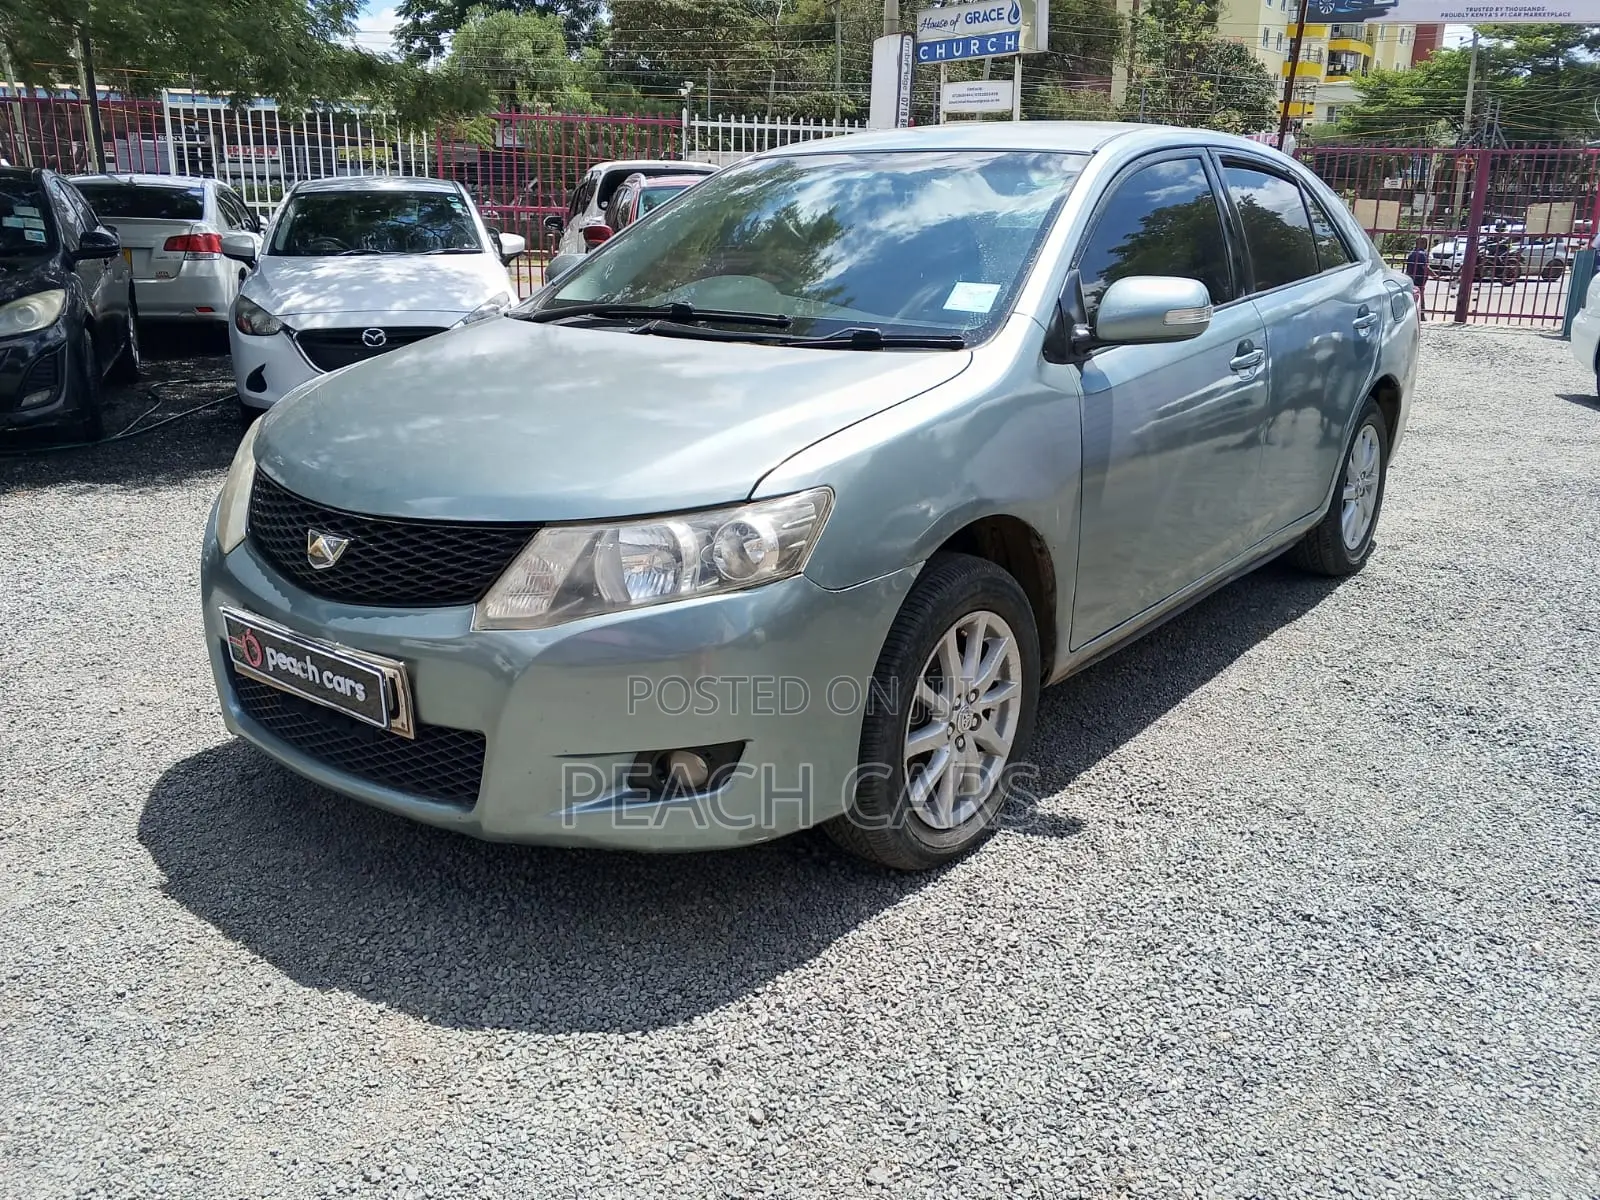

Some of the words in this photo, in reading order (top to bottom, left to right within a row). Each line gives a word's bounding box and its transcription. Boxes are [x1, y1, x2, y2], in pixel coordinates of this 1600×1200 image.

[919, 17, 949, 33] House
[949, 12, 961, 32] of
[964, 7, 1005, 25] GRACE
[919, 34, 1015, 60] CHURCH
[900, 97, 910, 117] 0718
[265, 646, 320, 684] peach
[322, 670, 366, 702] cars
